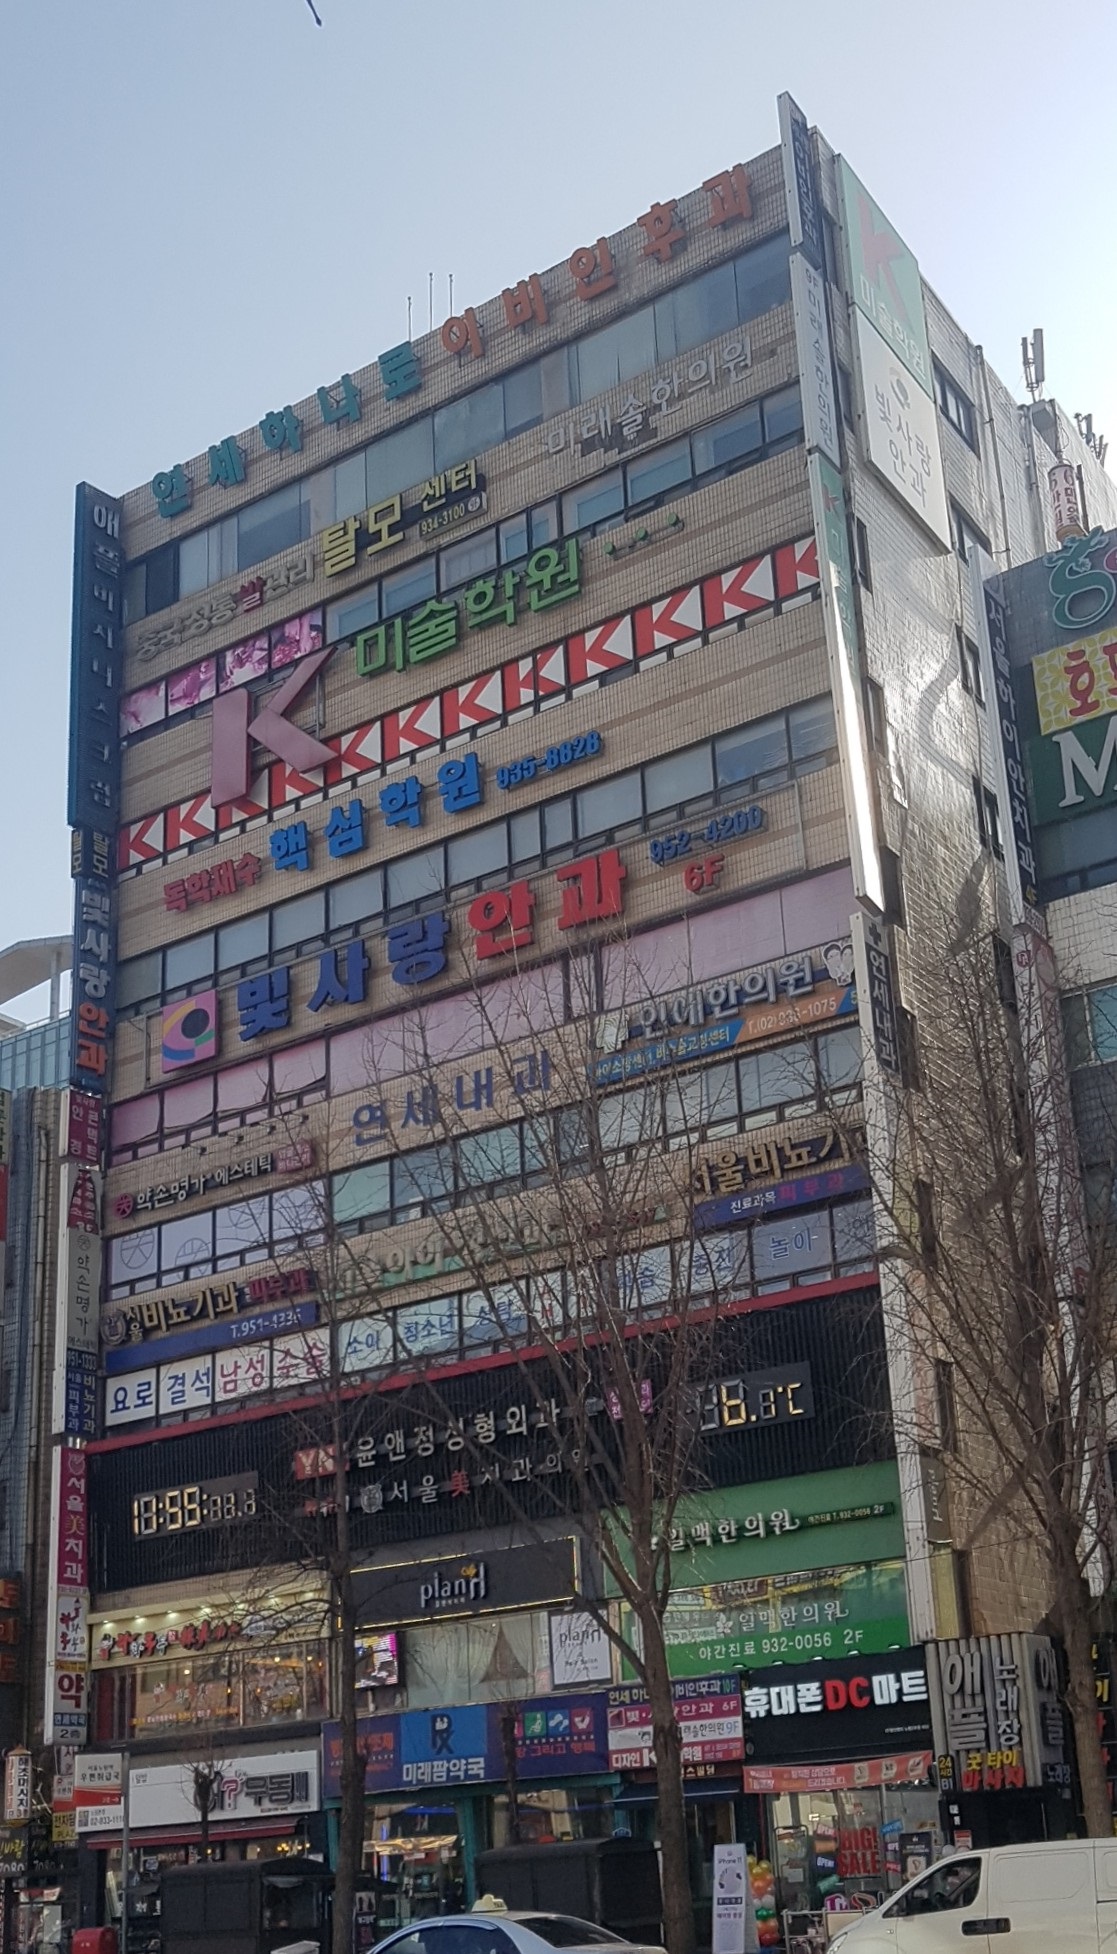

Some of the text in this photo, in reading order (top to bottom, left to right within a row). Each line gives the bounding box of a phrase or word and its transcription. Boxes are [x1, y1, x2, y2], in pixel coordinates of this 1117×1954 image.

[546, 337, 752, 456] 미래솔한의원
[321, 459, 478, 578] 탈모 센터
[421, 503, 465, 535] 934-3100
[356, 536, 580, 677] 미술학원
[210, 646, 341, 809] K
[269, 751, 483, 872] 핵심학원
[649, 804, 764, 865] 952-4200
[163, 851, 263, 912] 독학재수
[682, 853, 725, 895] 6F
[110, 1380, 153, 1414] 요로
[166, 1366, 212, 1406] 결석
[699, 1628, 864, 1661] 야간진료 932-0056 2F
[57, 1673, 85, 1709] 약
[722, 1700, 738, 1711] 6F
[725, 1721, 740, 1735] 9F
[402, 1756, 486, 1785] 미래팜약국
[836, 1852, 881, 1877] SALE
